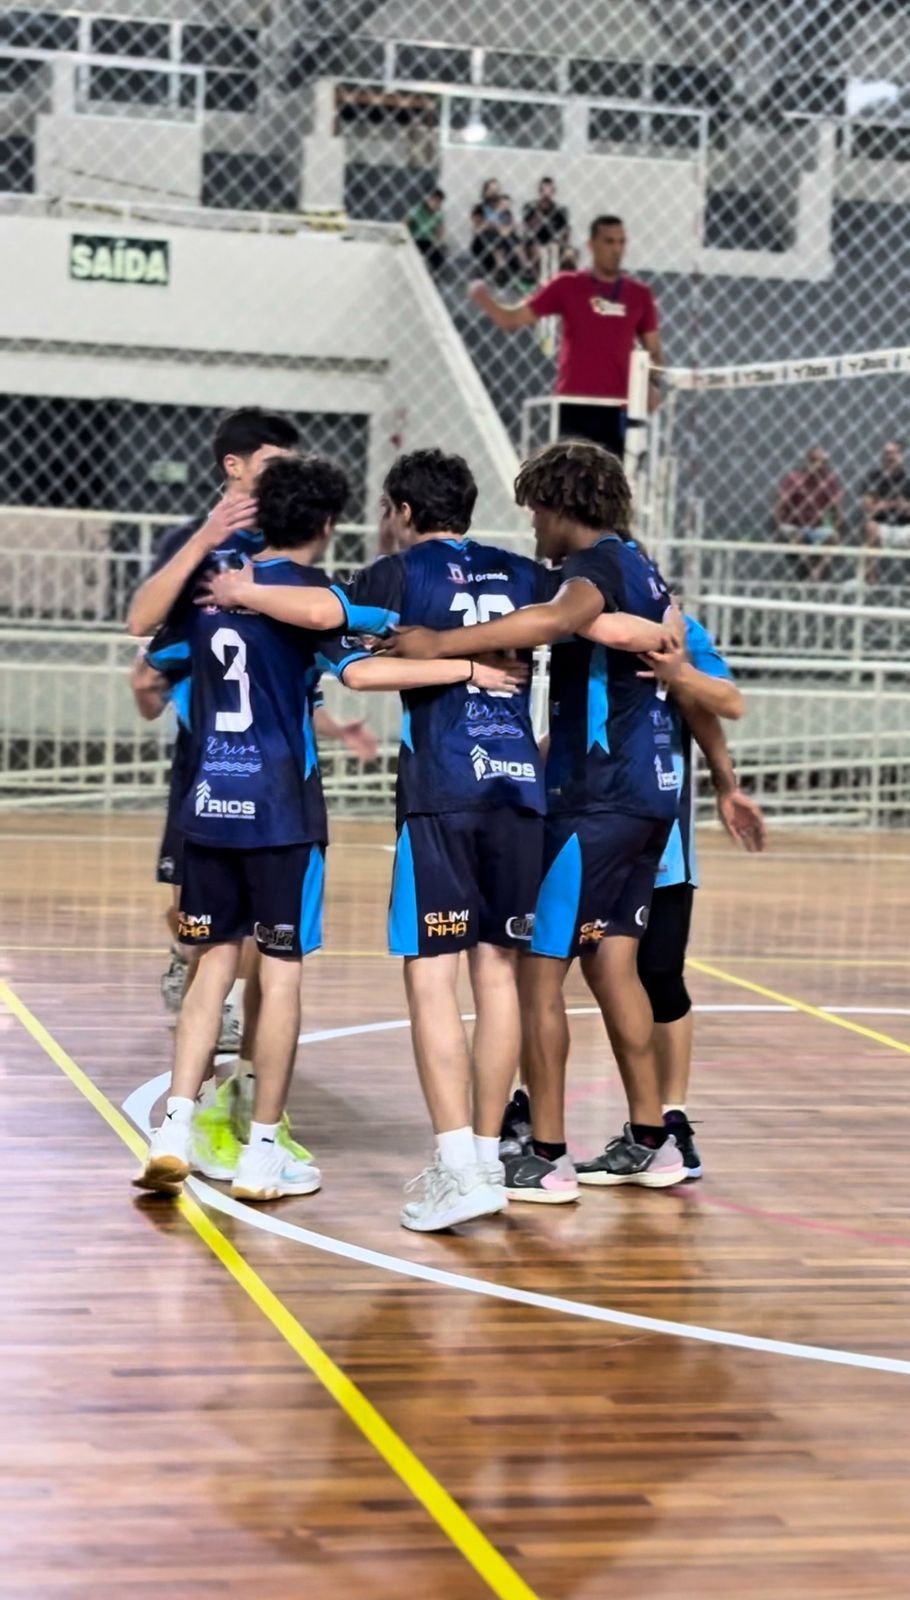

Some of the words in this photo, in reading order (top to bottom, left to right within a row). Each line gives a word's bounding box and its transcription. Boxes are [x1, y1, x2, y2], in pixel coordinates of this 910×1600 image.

[72, 240, 166, 282] SAÍDA
[211, 627, 253, 732] 3
[490, 759, 535, 777] RIOS
[208, 799, 256, 815] RIOS
